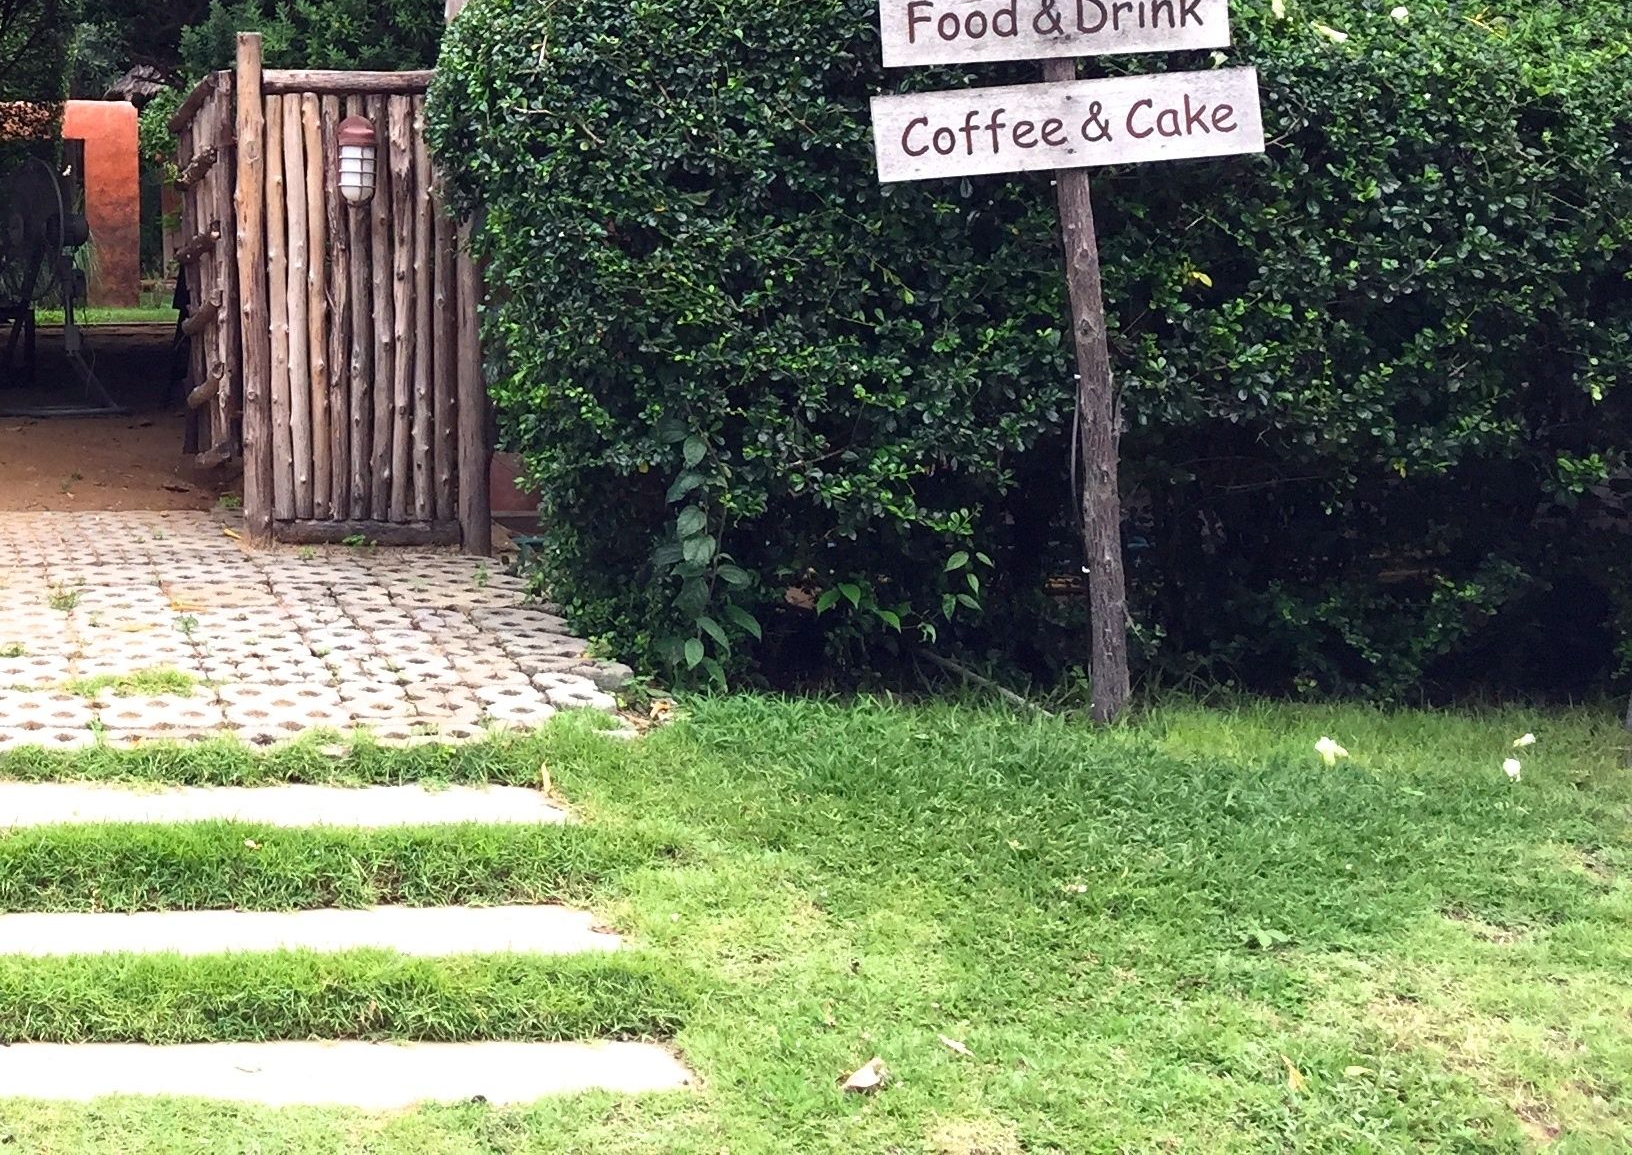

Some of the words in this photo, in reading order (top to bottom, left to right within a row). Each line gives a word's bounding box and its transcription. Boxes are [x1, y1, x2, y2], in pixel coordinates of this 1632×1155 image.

[901, 107, 1068, 158] Coffee
[1080, 100, 1113, 143] &
[1125, 93, 1238, 139] Cake
